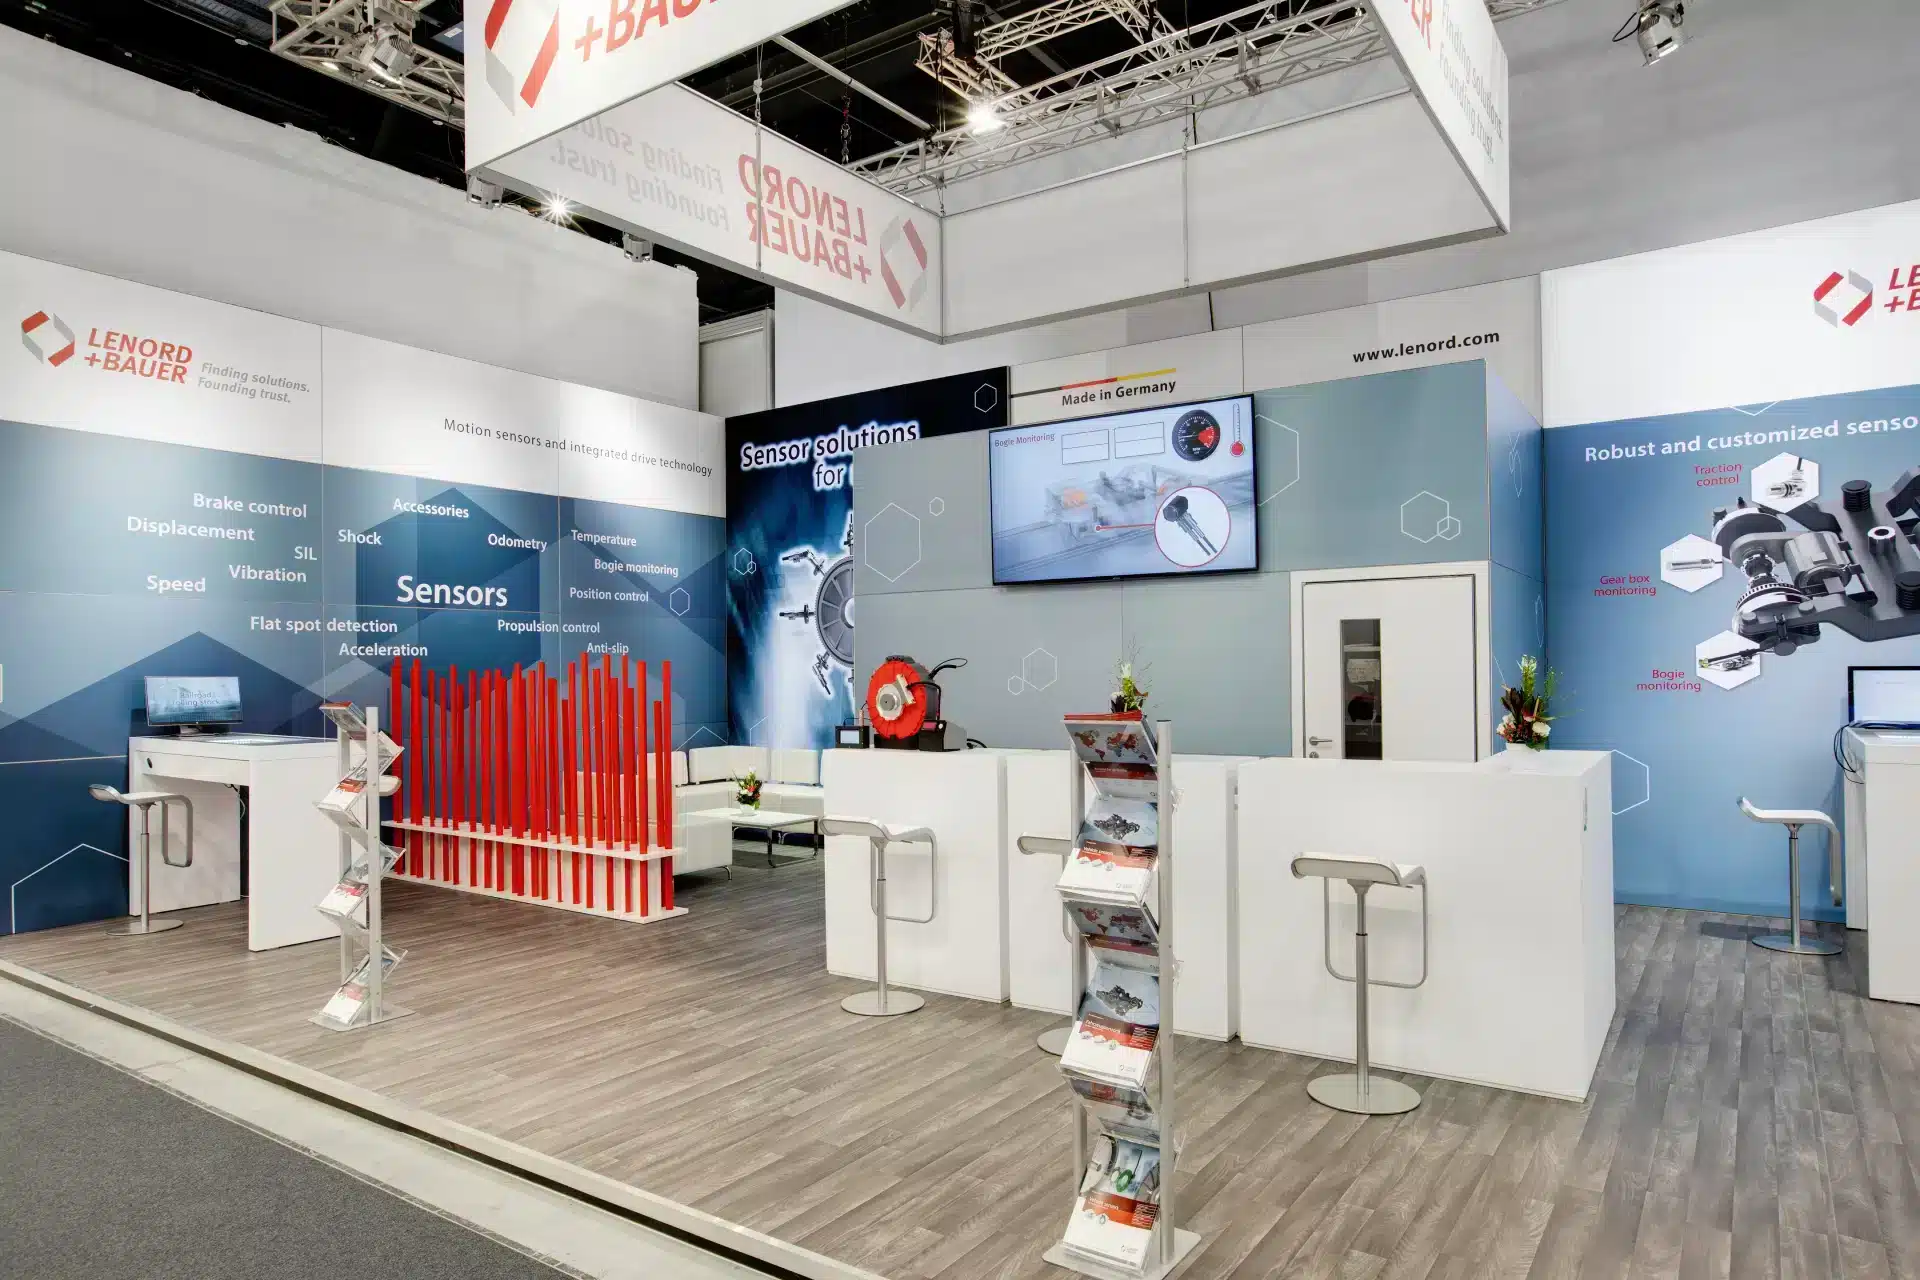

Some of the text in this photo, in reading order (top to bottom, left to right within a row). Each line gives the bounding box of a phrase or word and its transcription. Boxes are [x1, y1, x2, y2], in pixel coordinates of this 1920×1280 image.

[575, 0, 718, 62] +BA
[1440, 40, 1475, 134] Founding
[88, 328, 192, 364] LENORD
[1353, 332, 1500, 363] www.lenord.com
[84, 352, 188, 384] +BAUER
[201, 362, 310, 393] Finding solutions.
[198, 377, 291, 403] Founding trust.
[1062, 381, 1176, 406] Made in Germany
[443, 418, 713, 478] Motion sensors and integrated drive technology
[743, 424, 917, 467] Sensor solutions
[994, 432, 1055, 449] Bogie Monitoring
[1585, 415, 1919, 462] Robust and customized senso
[815, 464, 844, 487] for
[1693, 463, 1743, 475] Traction
[1696, 474, 1739, 487] control
[193, 493, 307, 518] Brake control
[393, 498, 469, 518] Accessories
[127, 516, 255, 541] Displacement
[338, 529, 382, 546] Shock
[570, 529, 637, 547] Temperature
[487, 533, 547, 552] Odometry
[294, 546, 317, 561] SIL
[229, 564, 307, 583] Vibration
[594, 558, 679, 578] Bogie monitoring
[147, 575, 206, 595] Speed
[396, 574, 508, 607] Sensors
[1600, 574, 1650, 587] Gear box
[569, 587, 649, 602] Position control
[1594, 585, 1657, 597] monitoring
[250, 616, 398, 634] Flat spot detection
[497, 619, 600, 635] Propulsion control
[339, 642, 428, 657] Acceleration
[586, 641, 629, 657] Anti-slip
[1652, 669, 1685, 681] Bogie
[1636, 680, 1701, 692] monitoring
